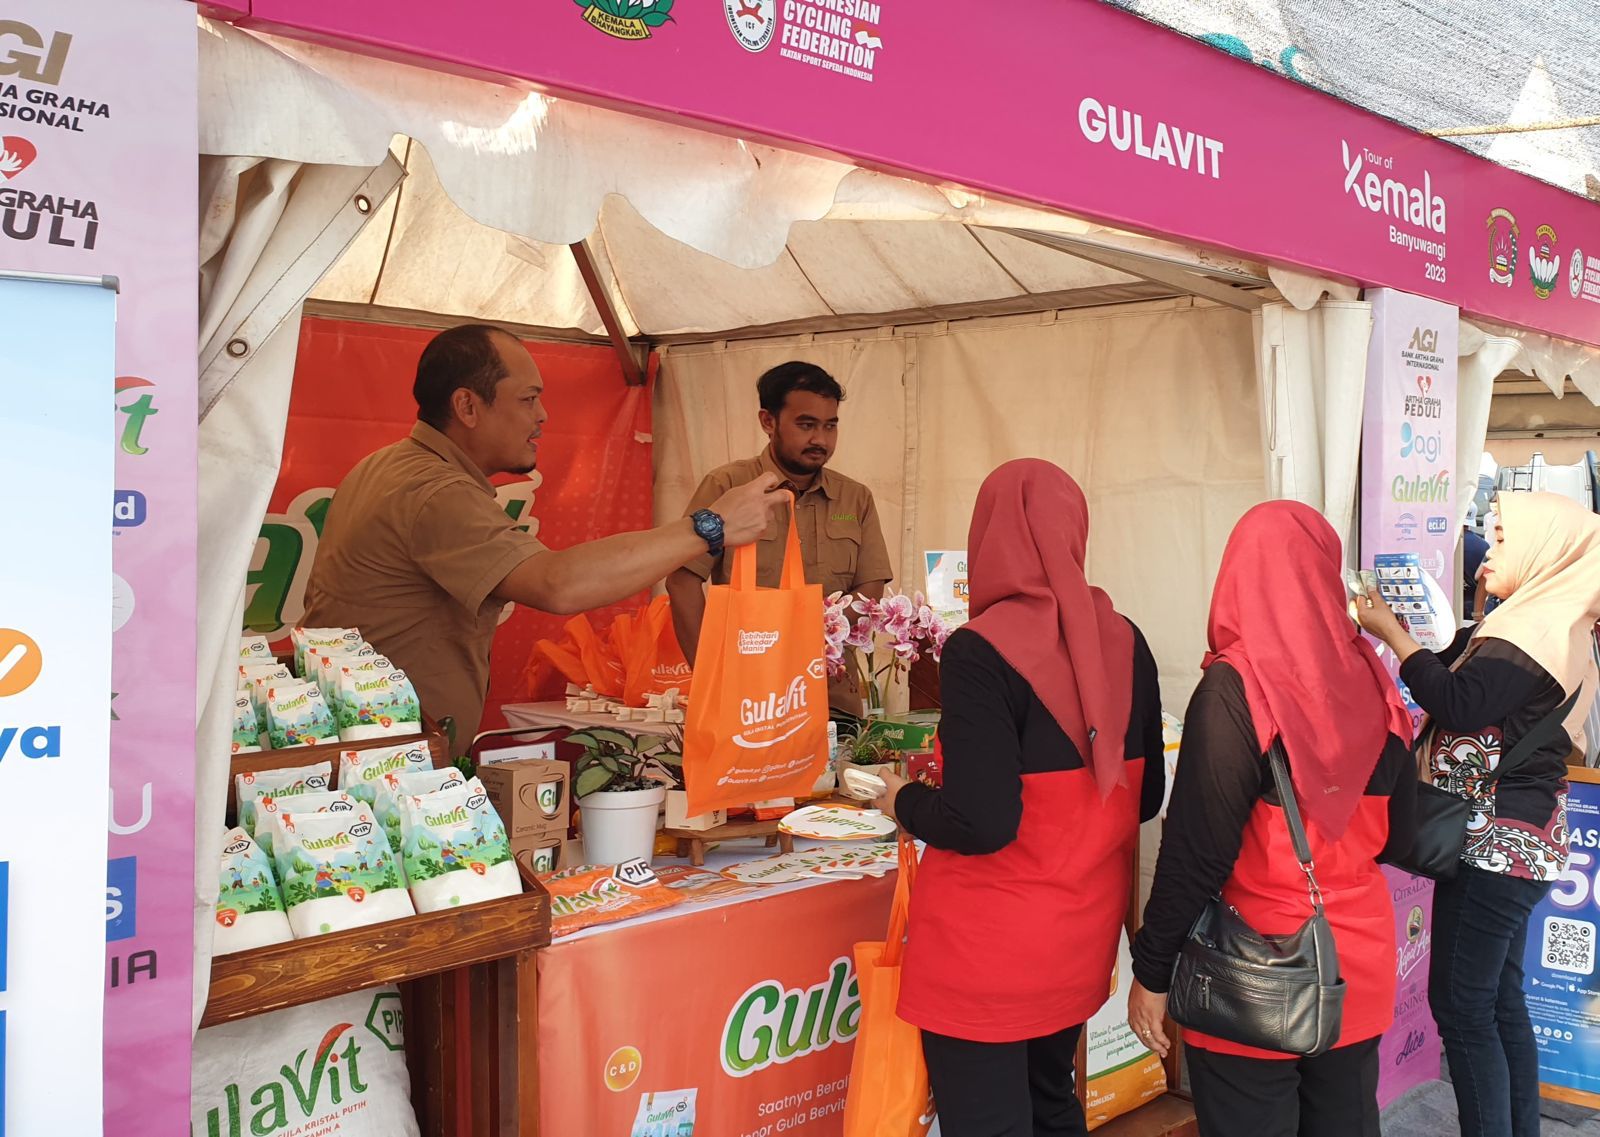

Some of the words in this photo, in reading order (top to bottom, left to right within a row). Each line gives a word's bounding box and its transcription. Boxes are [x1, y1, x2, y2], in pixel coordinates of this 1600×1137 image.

[591, 15, 643, 37] BHAYANGKARI
[598, 11, 636, 28] KEMALA
[783, 0, 852, 40] CYCLING
[781, 23, 875, 70] FEDERATION
[26, 89, 110, 118] GRAHA
[1078, 96, 1224, 180] GULAVIT
[1363, 147, 1382, 167] Tour
[1384, 156, 1393, 170] of
[1341, 139, 1446, 234] Kemala
[1389, 224, 1446, 262] Banyuwangi
[1425, 262, 1446, 283] 2023
[1408, 326, 1438, 353] AGI
[1401, 350, 1414, 359] BANK
[1414, 353, 1429, 361] ARTHA
[1429, 356, 1444, 364] GRAHA
[1404, 403, 1442, 419] PEDULI
[1405, 395, 1423, 405] ARTHA
[1424, 397, 1442, 407] GRAHA
[1391, 470, 1450, 504] GulaVit
[813, 663, 824, 674] PI
[354, 676, 390, 693] GulaVit
[276, 693, 308, 713] GulaVit
[740, 675, 807, 726] GulaVit
[362, 752, 408, 782] GulaVit
[334, 804, 349, 812] PIR
[470, 796, 484, 807] PIR
[424, 806, 470, 828] GulaVit
[353, 825, 369, 834] PIR
[229, 841, 245, 853] PIR
[301, 831, 352, 851] GulaVit
[1540, 981, 1556, 990] Google
[1576, 987, 1587, 995] App
[609, 1066, 618, 1077] C
[619, 1063, 626, 1074] &
[628, 1061, 636, 1072] D
[758, 1089, 814, 1117] Saatnya
[304, 1111, 341, 1131] KRISTAL
[342, 1099, 368, 1115] PUTIH
[776, 1112, 806, 1132] Gula
[809, 1098, 848, 1121] Bervit
